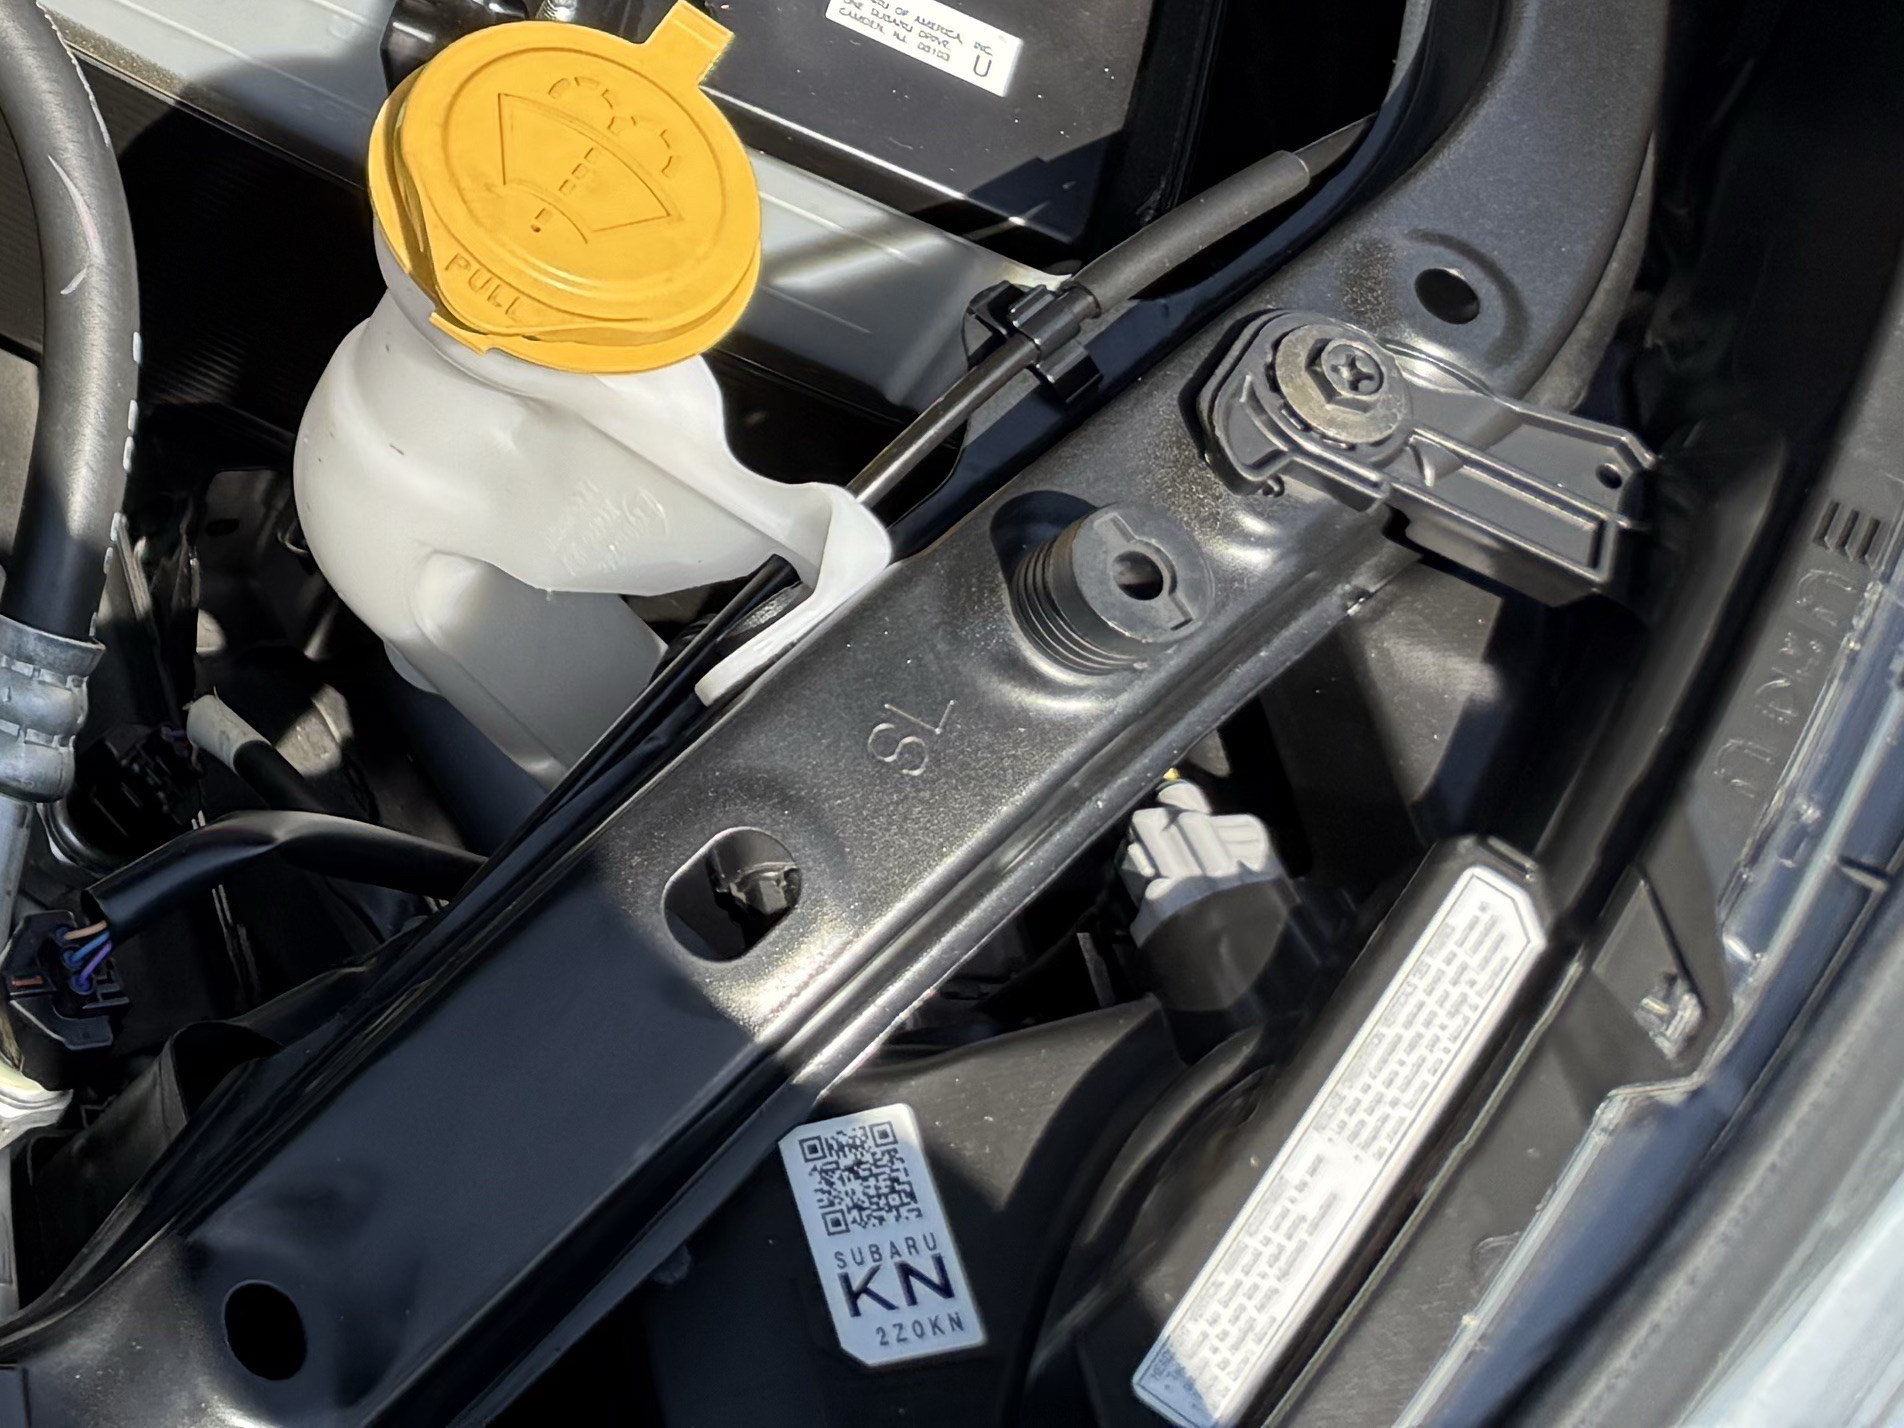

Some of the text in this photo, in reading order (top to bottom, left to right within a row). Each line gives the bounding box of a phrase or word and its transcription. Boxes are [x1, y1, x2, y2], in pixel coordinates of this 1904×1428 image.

[445, 252, 525, 321] PULL
[833, 1231, 938, 1271] SUBARU
[837, 1251, 956, 1318] KN
